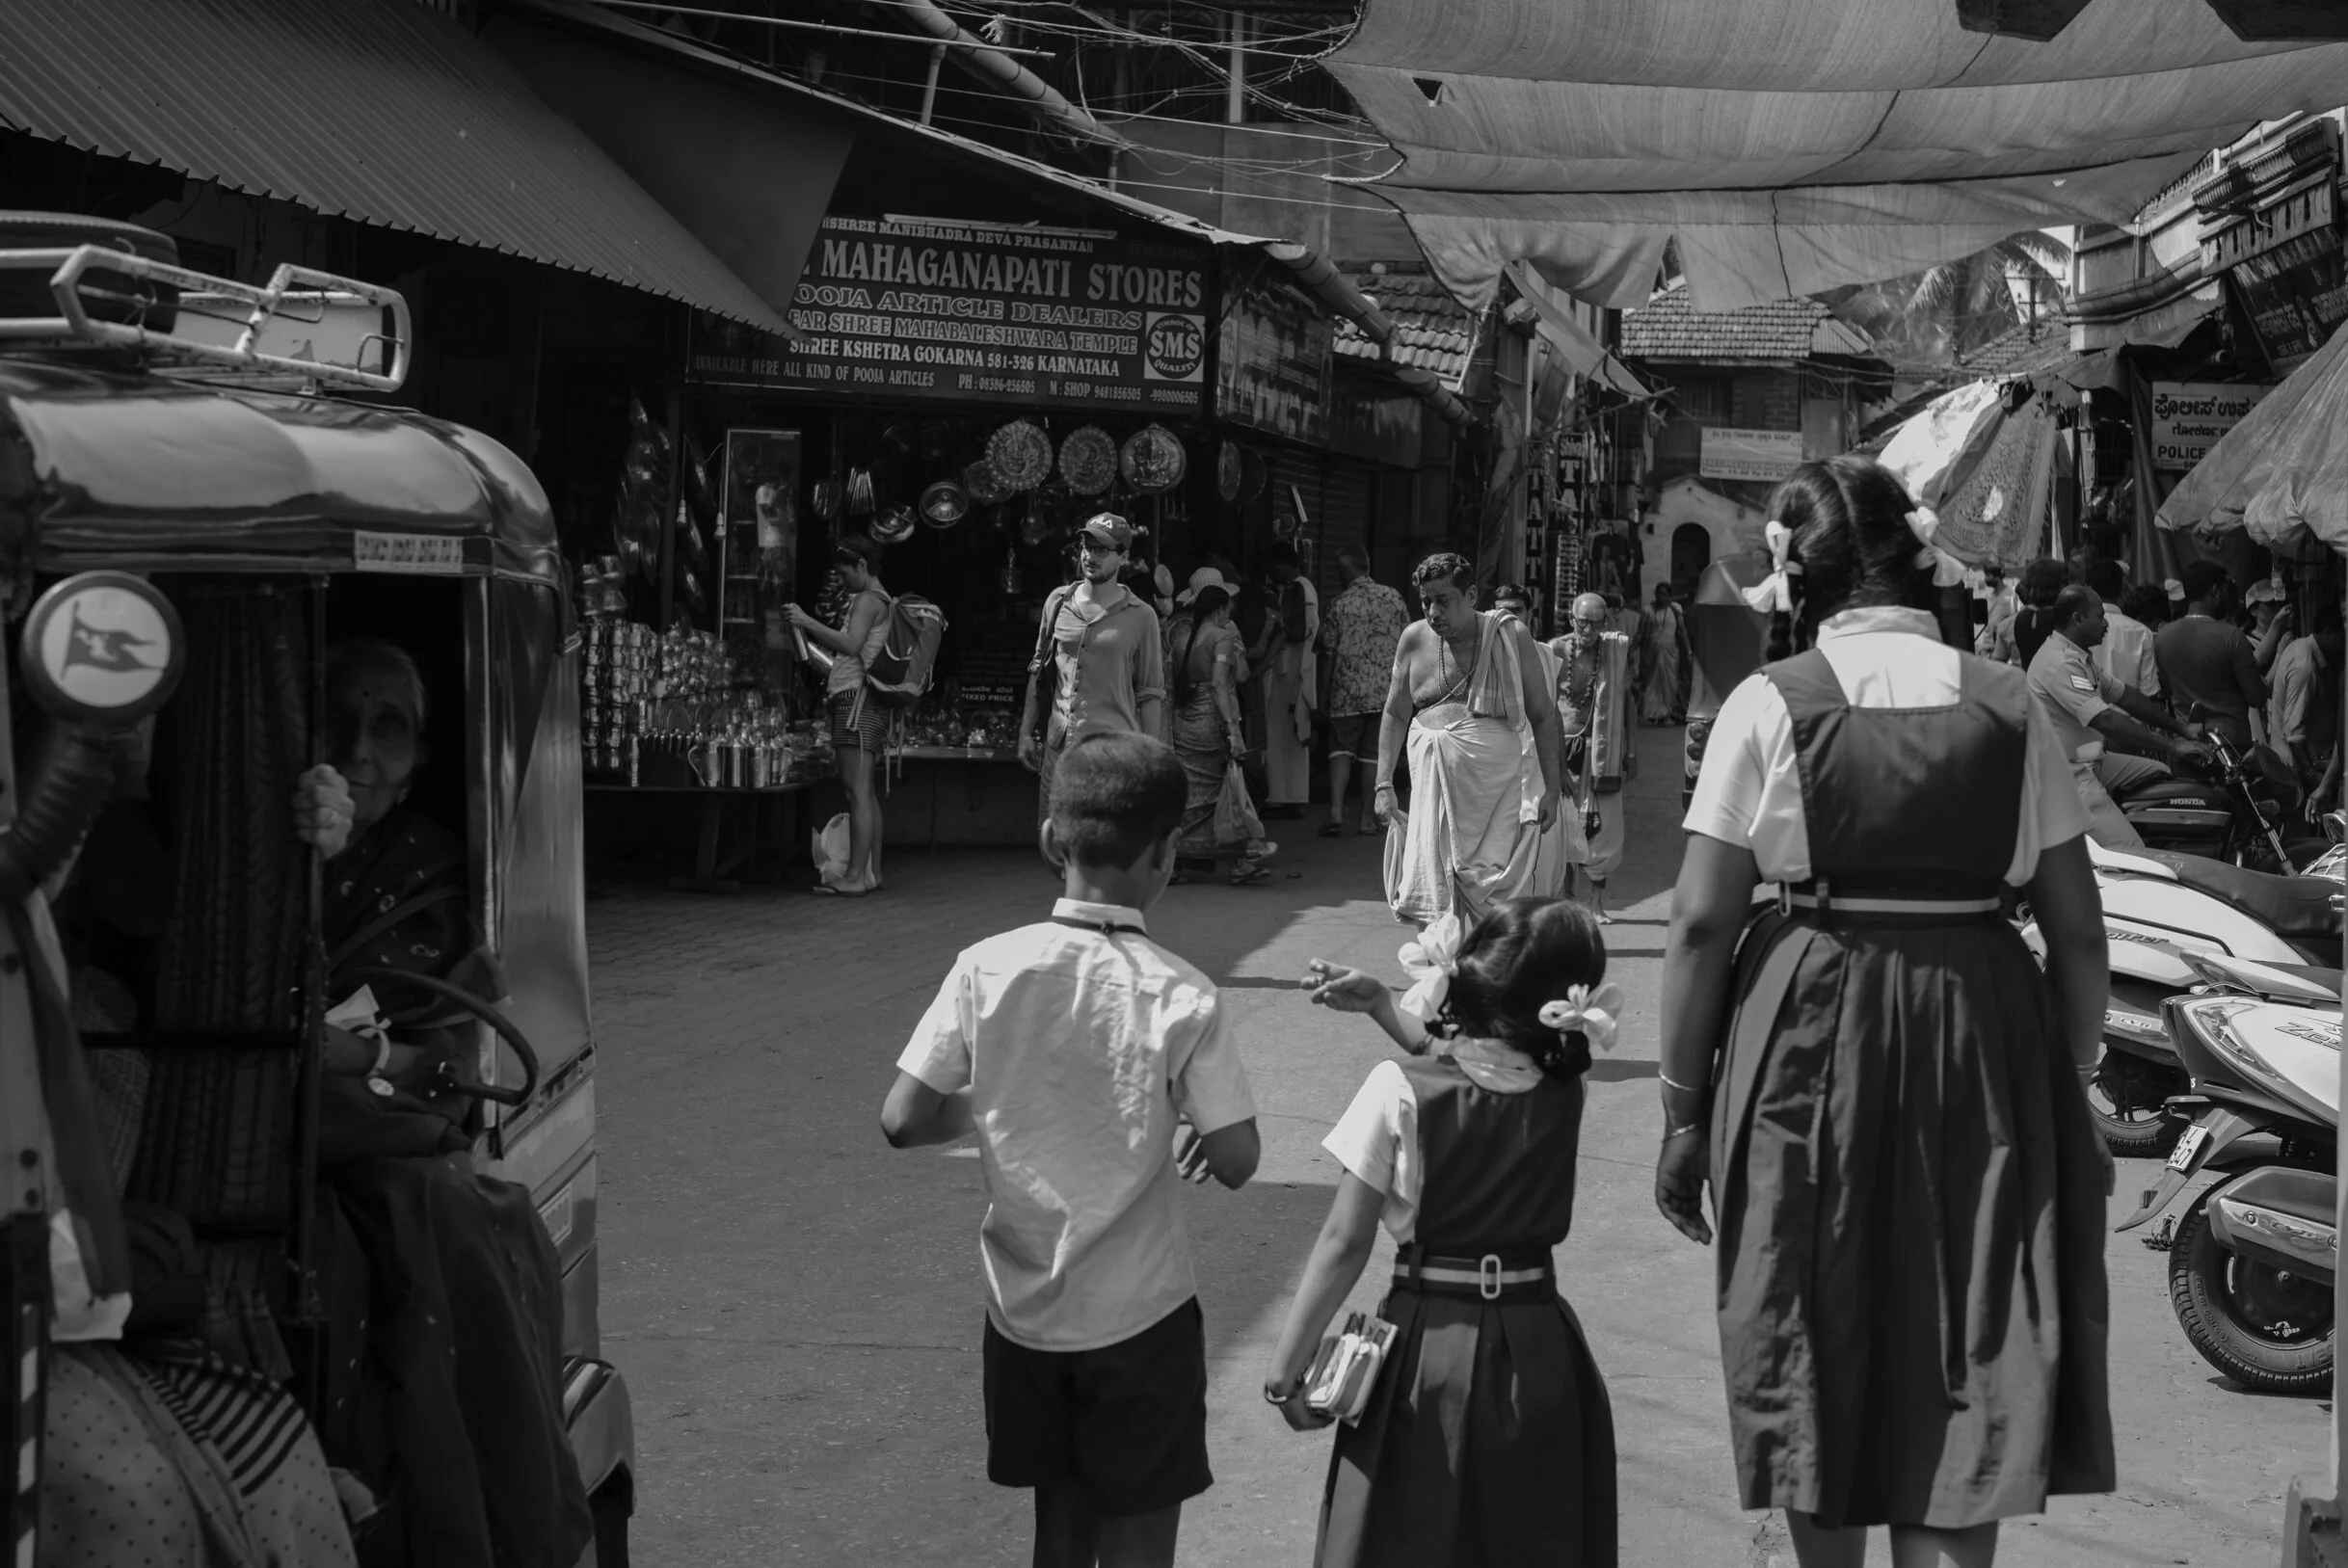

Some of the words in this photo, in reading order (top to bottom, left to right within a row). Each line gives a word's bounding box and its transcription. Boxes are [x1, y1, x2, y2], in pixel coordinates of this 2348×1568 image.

[879, 222, 973, 243] MANIBHADRA
[975, 231, 1012, 247] DEVA
[821, 239, 1072, 298] MAHAGANAPATI
[1086, 262, 1202, 308] STORES
[877, 290, 1004, 320] ARTICLE
[1010, 302, 1143, 332] DEALERS
[828, 312, 892, 336] SHREE
[894, 317, 1068, 351] MAHABALESHWARA
[1070, 331, 1138, 355] TEMPLE
[1149, 331, 1201, 360] SMS
[694, 355, 747, 374] AVAILABLE
[752, 359, 779, 376] HERE
[783, 362, 802, 378] ALL
[806, 363, 831, 380] KIND
[836, 366, 850, 382] OF
[854, 366, 885, 384] POOJA
[889, 369, 935, 387] ARTICLES
[842, 338, 912, 362] KSHETRA
[914, 345, 985, 367] GOKARNA
[987, 353, 1034, 373] 581-326
[1037, 355, 1120, 378] KARNATAKA
[1153, 360, 1196, 372] QUALITY
[2157, 445, 2207, 460] POLICE
[987, 694, 1015, 703] PRICE
